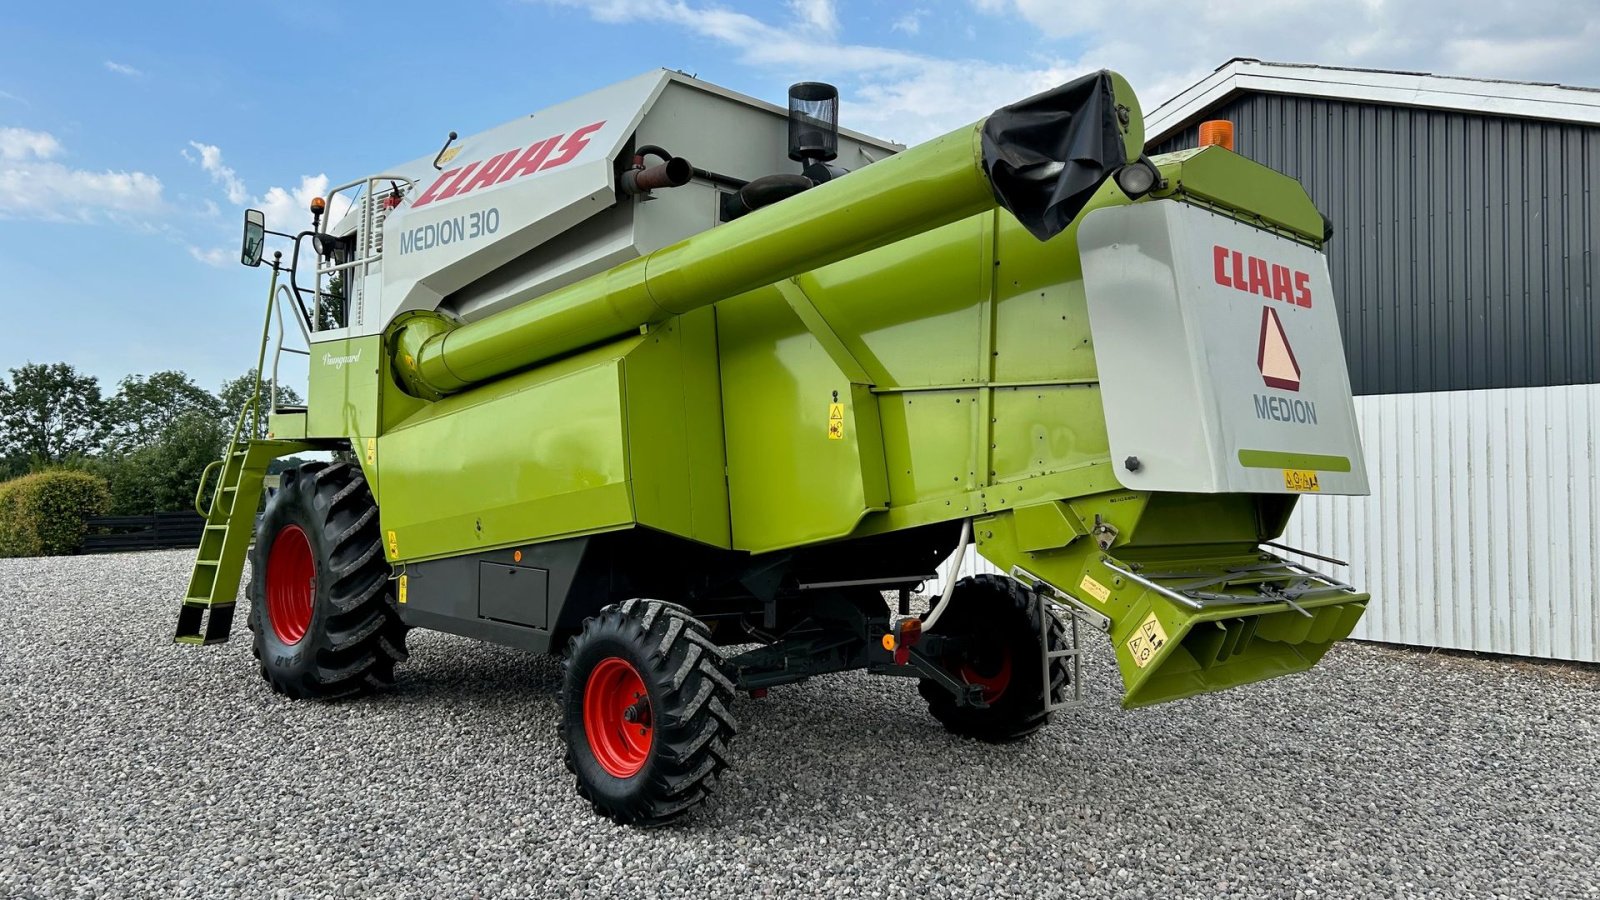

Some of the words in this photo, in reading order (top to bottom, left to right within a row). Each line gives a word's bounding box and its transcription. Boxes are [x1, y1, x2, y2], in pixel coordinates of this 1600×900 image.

[411, 120, 607, 208] CLAAS
[400, 215, 465, 255] MEDION
[469, 207, 500, 239] 310
[1213, 244, 1312, 309] CLAAS
[1253, 393, 1318, 425] MEDION
